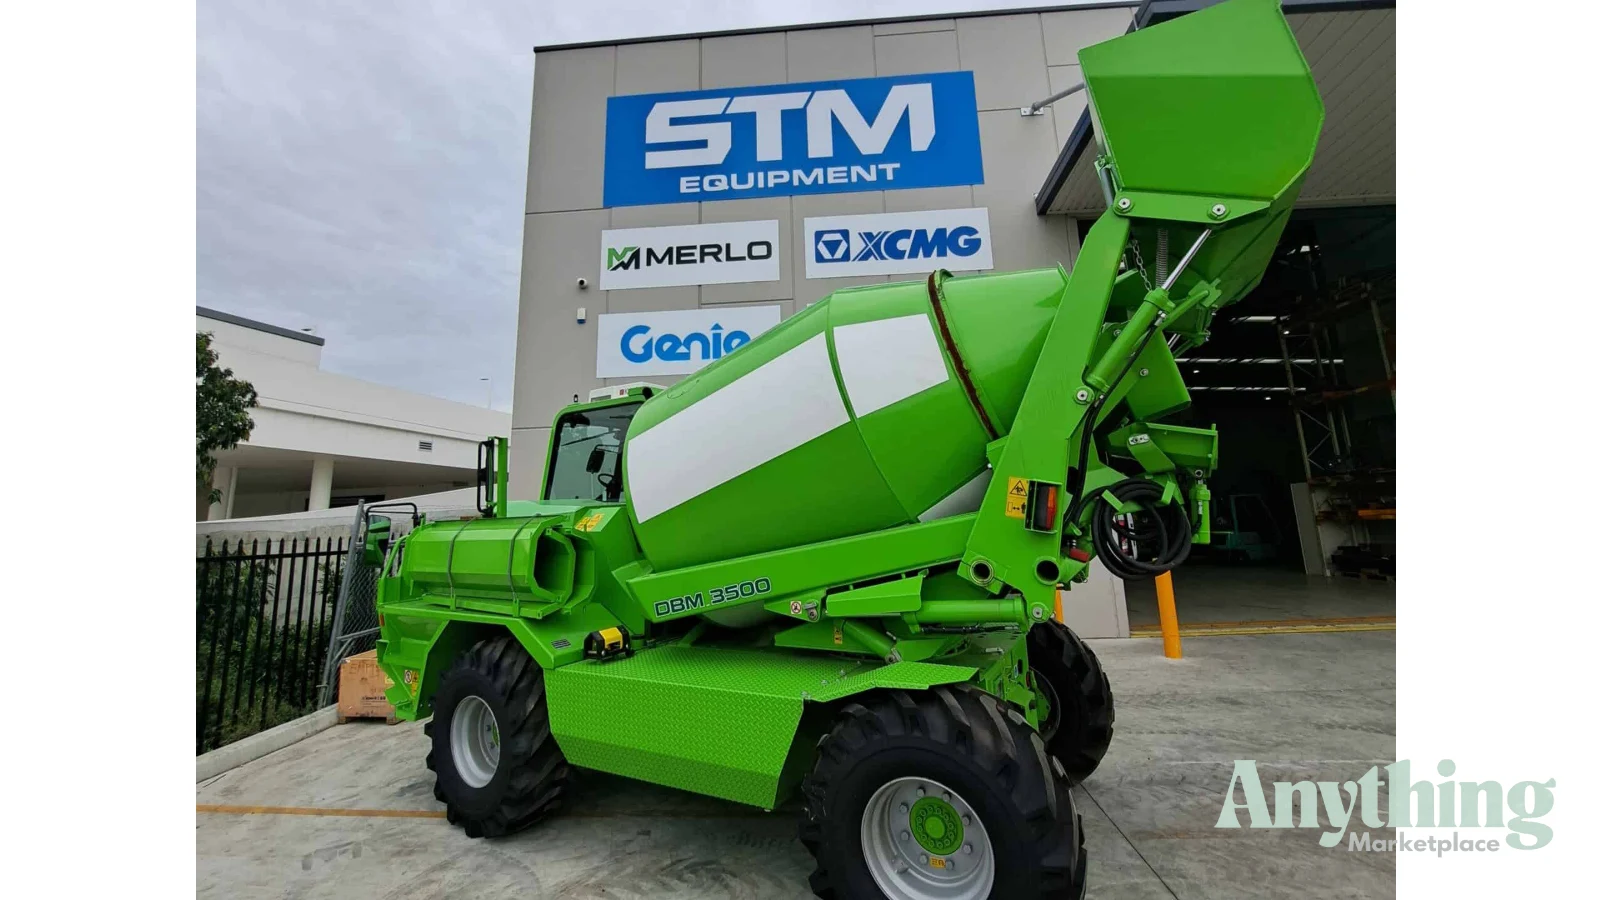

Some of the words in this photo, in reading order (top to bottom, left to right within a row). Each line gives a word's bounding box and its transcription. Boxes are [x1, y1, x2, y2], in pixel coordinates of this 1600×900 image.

[645, 83, 936, 169] STM
[679, 163, 900, 193] EQUIPMENT
[646, 241, 772, 266] MERLO
[853, 226, 982, 261] XCMG
[654, 592, 704, 617] DBM
[709, 577, 771, 604] 3500
